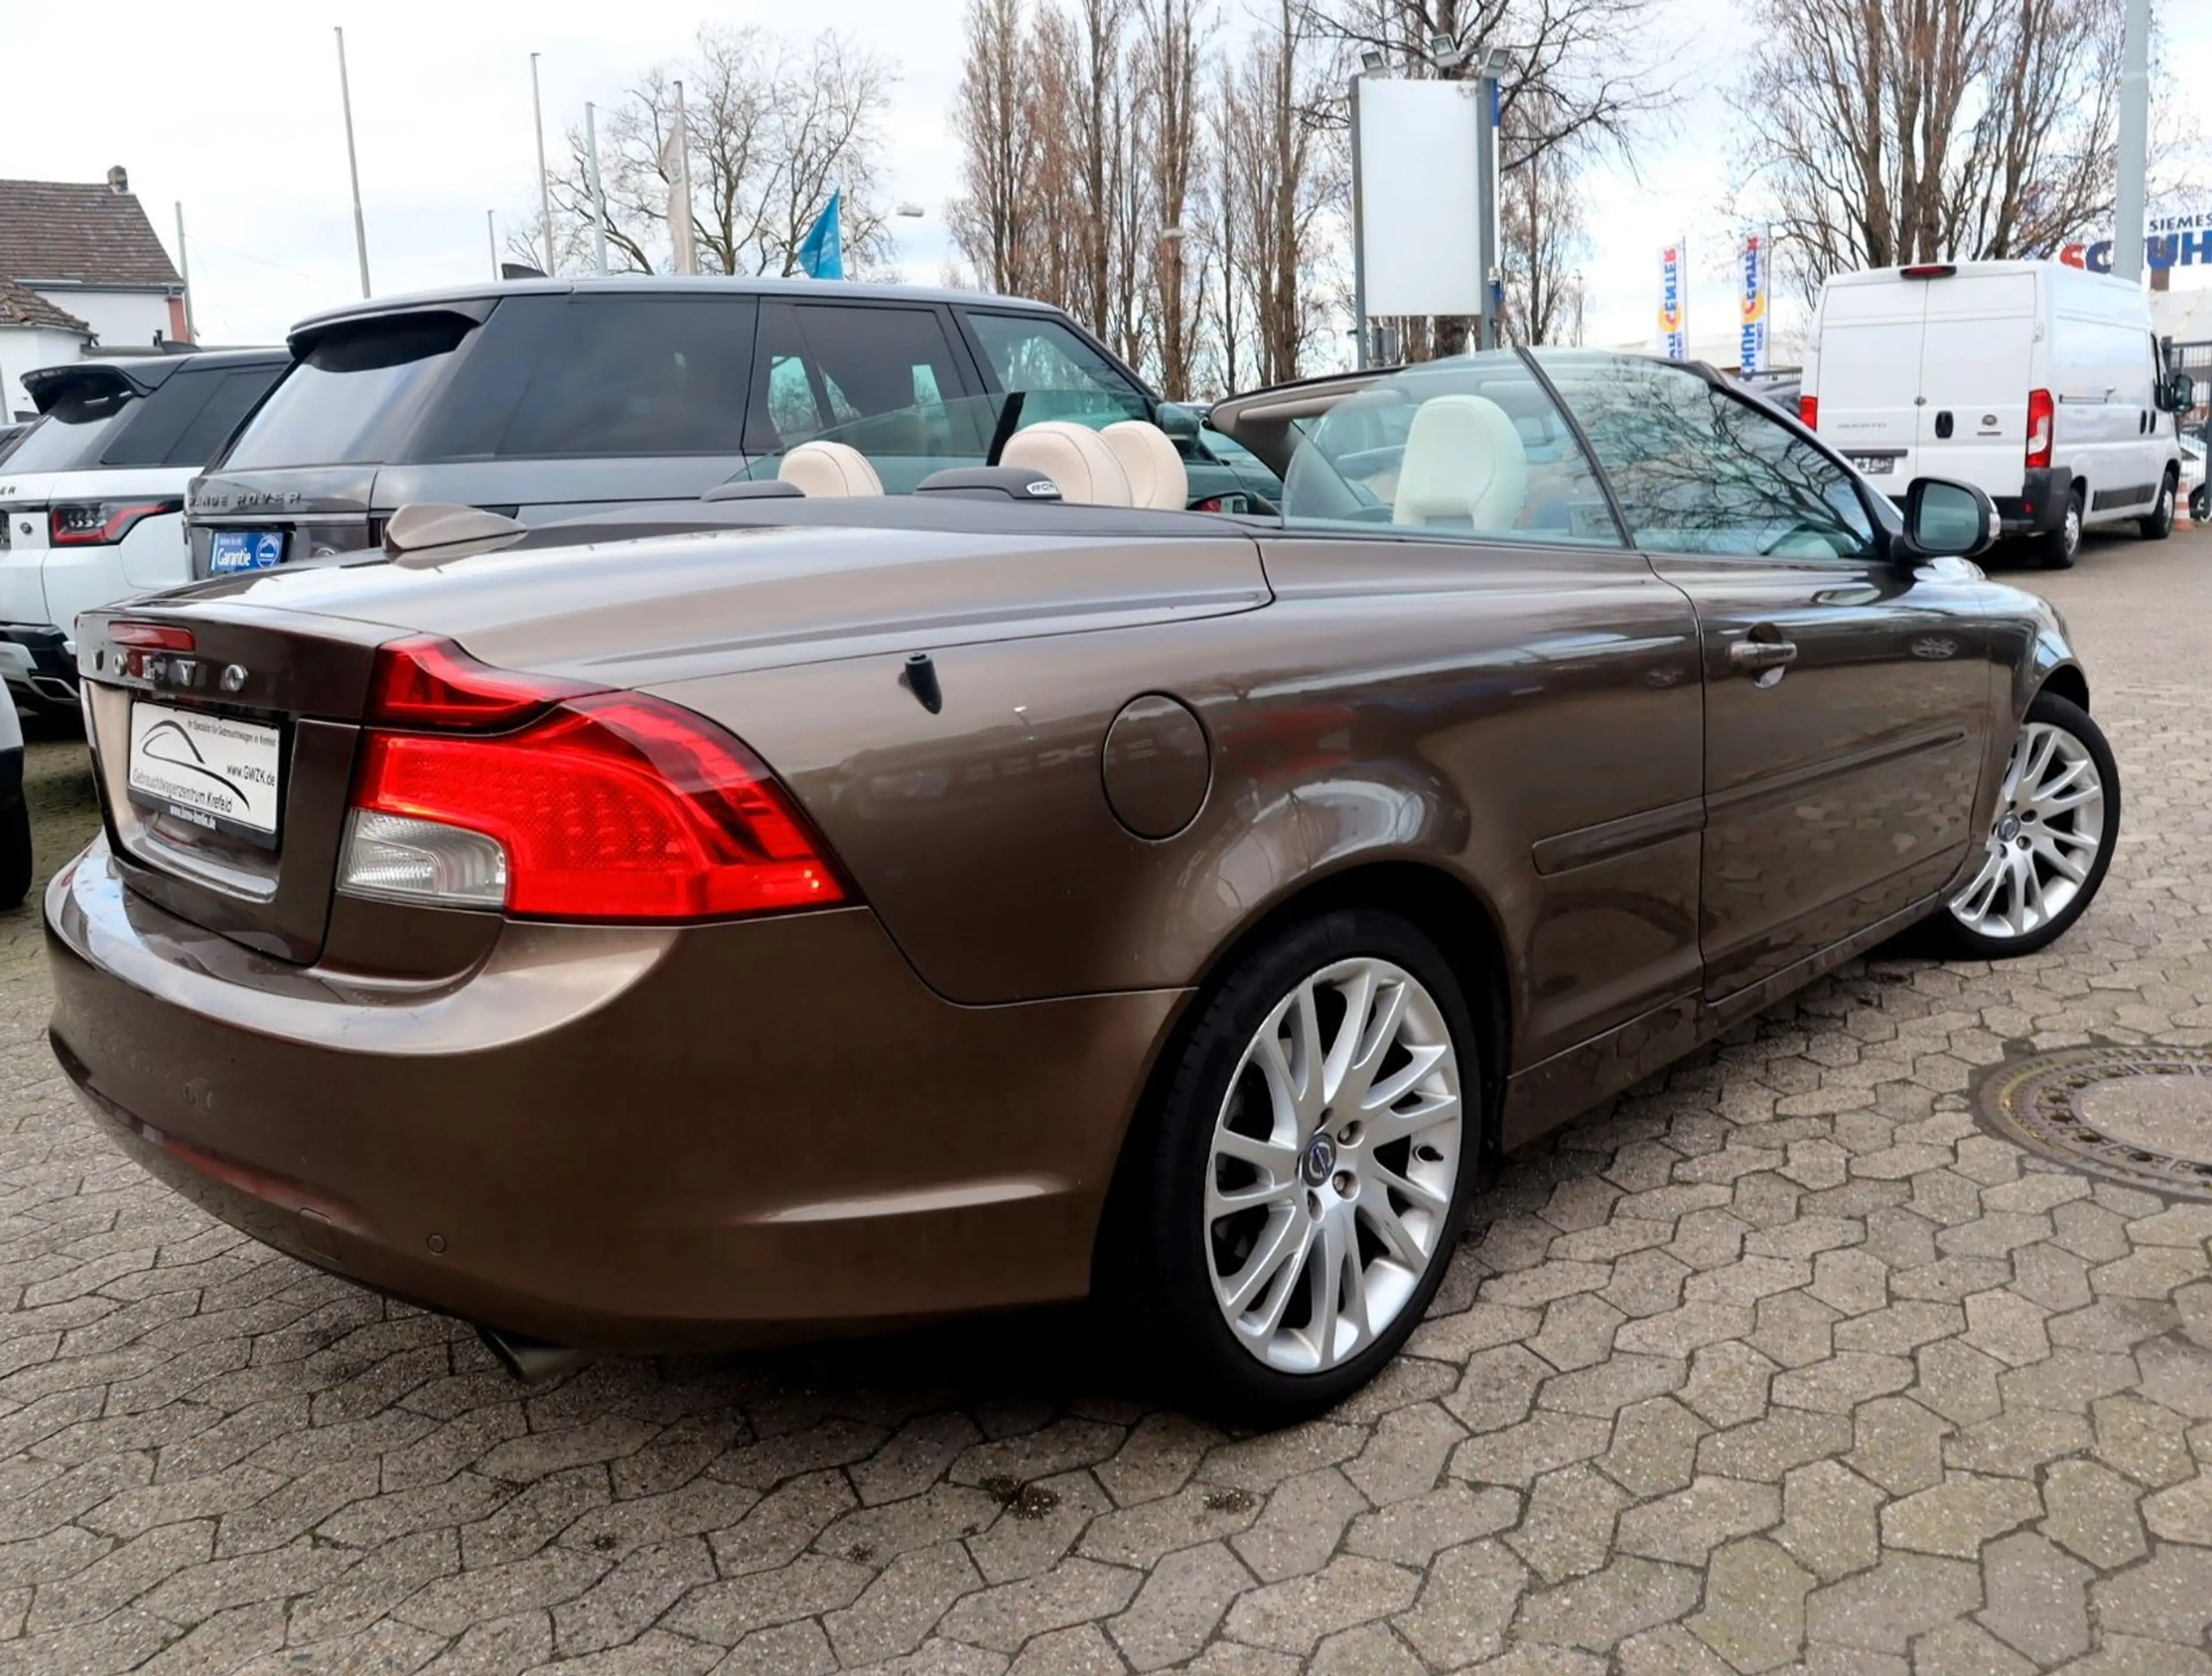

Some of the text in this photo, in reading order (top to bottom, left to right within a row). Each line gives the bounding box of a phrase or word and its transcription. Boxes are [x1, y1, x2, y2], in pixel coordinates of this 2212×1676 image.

[2149, 214, 2212, 232] SIEMES
[2060, 230, 2212, 274] SCUH
[189, 491, 300, 507] RANGE ROVER
[217, 547, 251, 566] Garantie
[91, 649, 248, 691] VOLVO
[226, 764, 275, 787] www.GWZK.de
[205, 791, 233, 813] Krefeld
